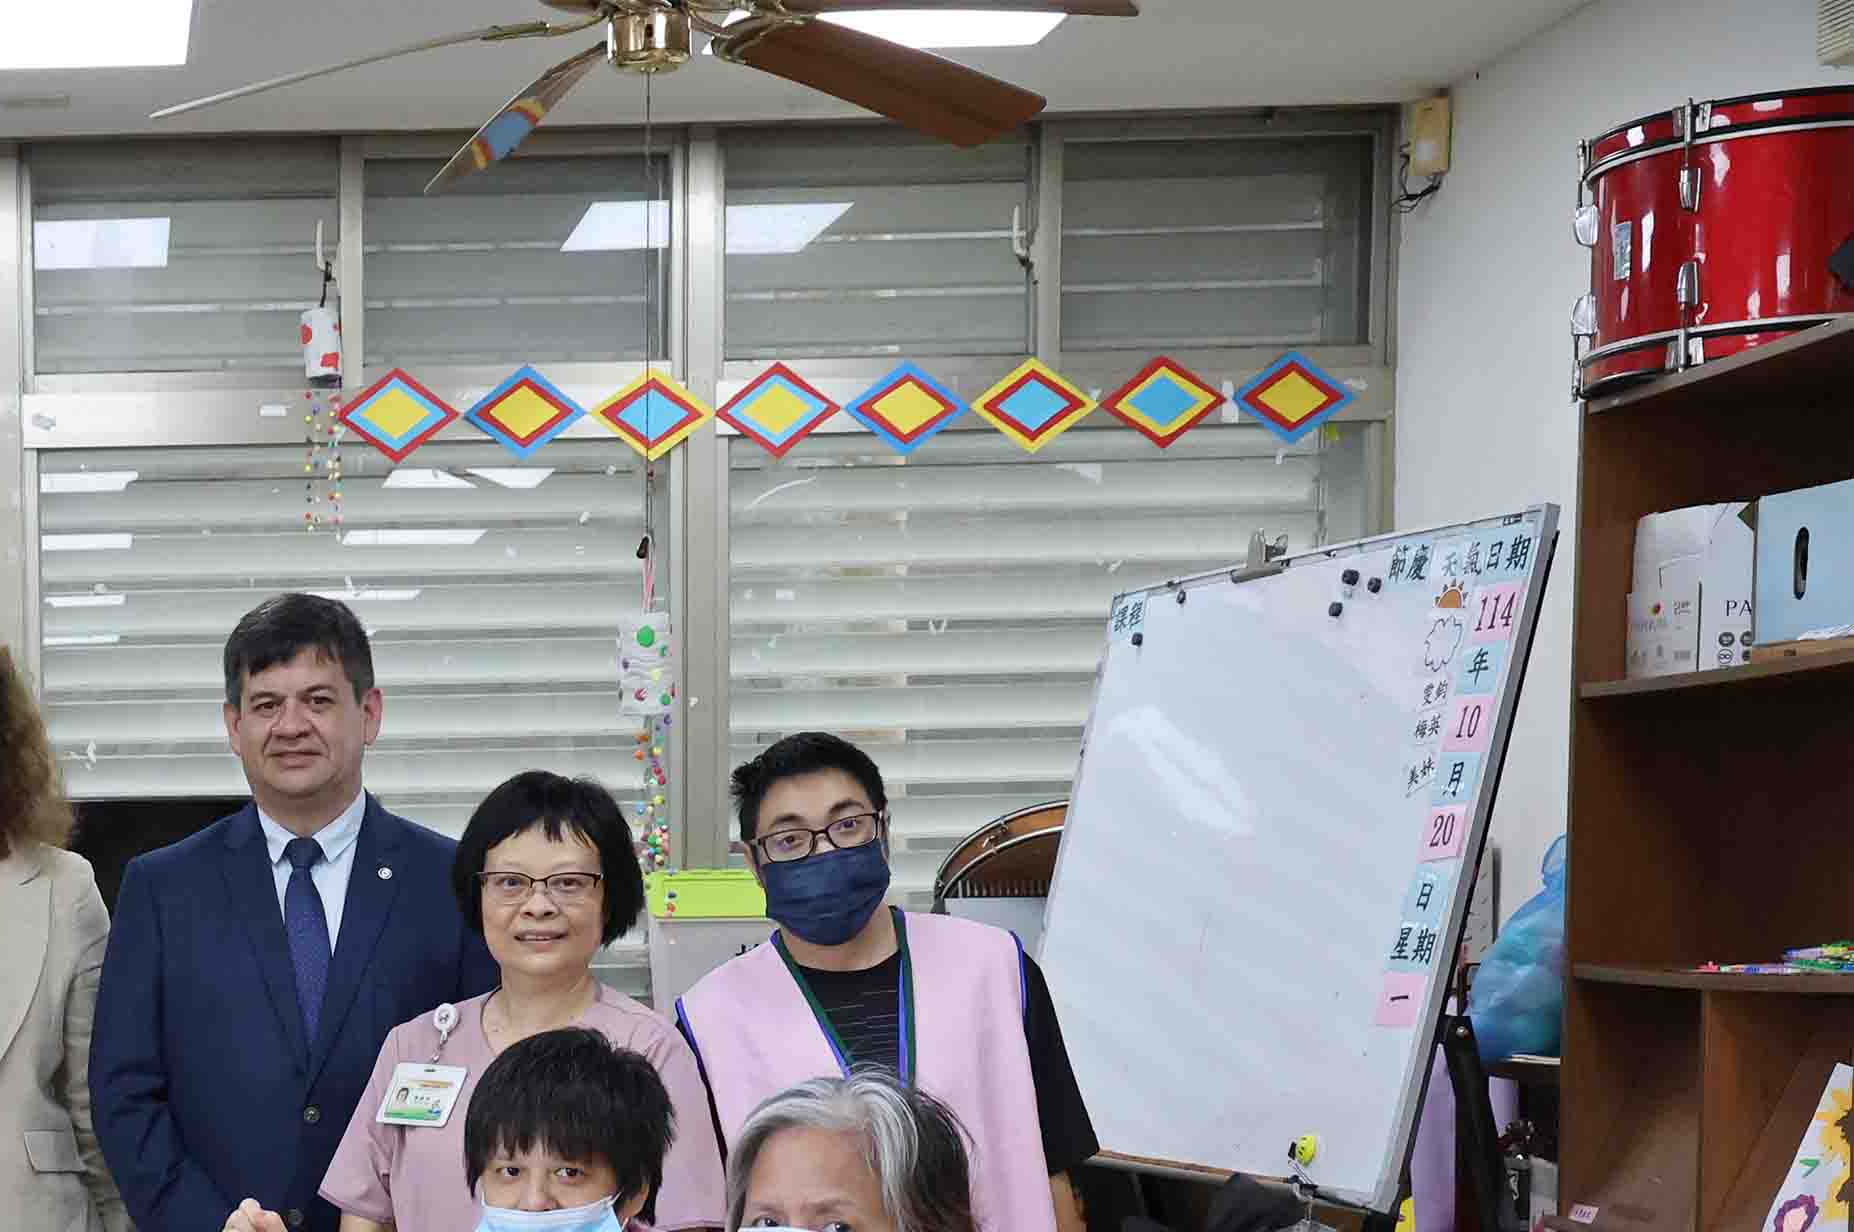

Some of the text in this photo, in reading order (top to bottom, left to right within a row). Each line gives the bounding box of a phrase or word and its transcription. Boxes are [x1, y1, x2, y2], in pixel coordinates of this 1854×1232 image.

[1486, 533, 1532, 570] 日期
[1474, 591, 1516, 632] 114
[1468, 648, 1489, 685] 年
[1456, 705, 1481, 738] 10
[1429, 813, 1455, 848] 20
[1390, 927, 1437, 965] 星期
